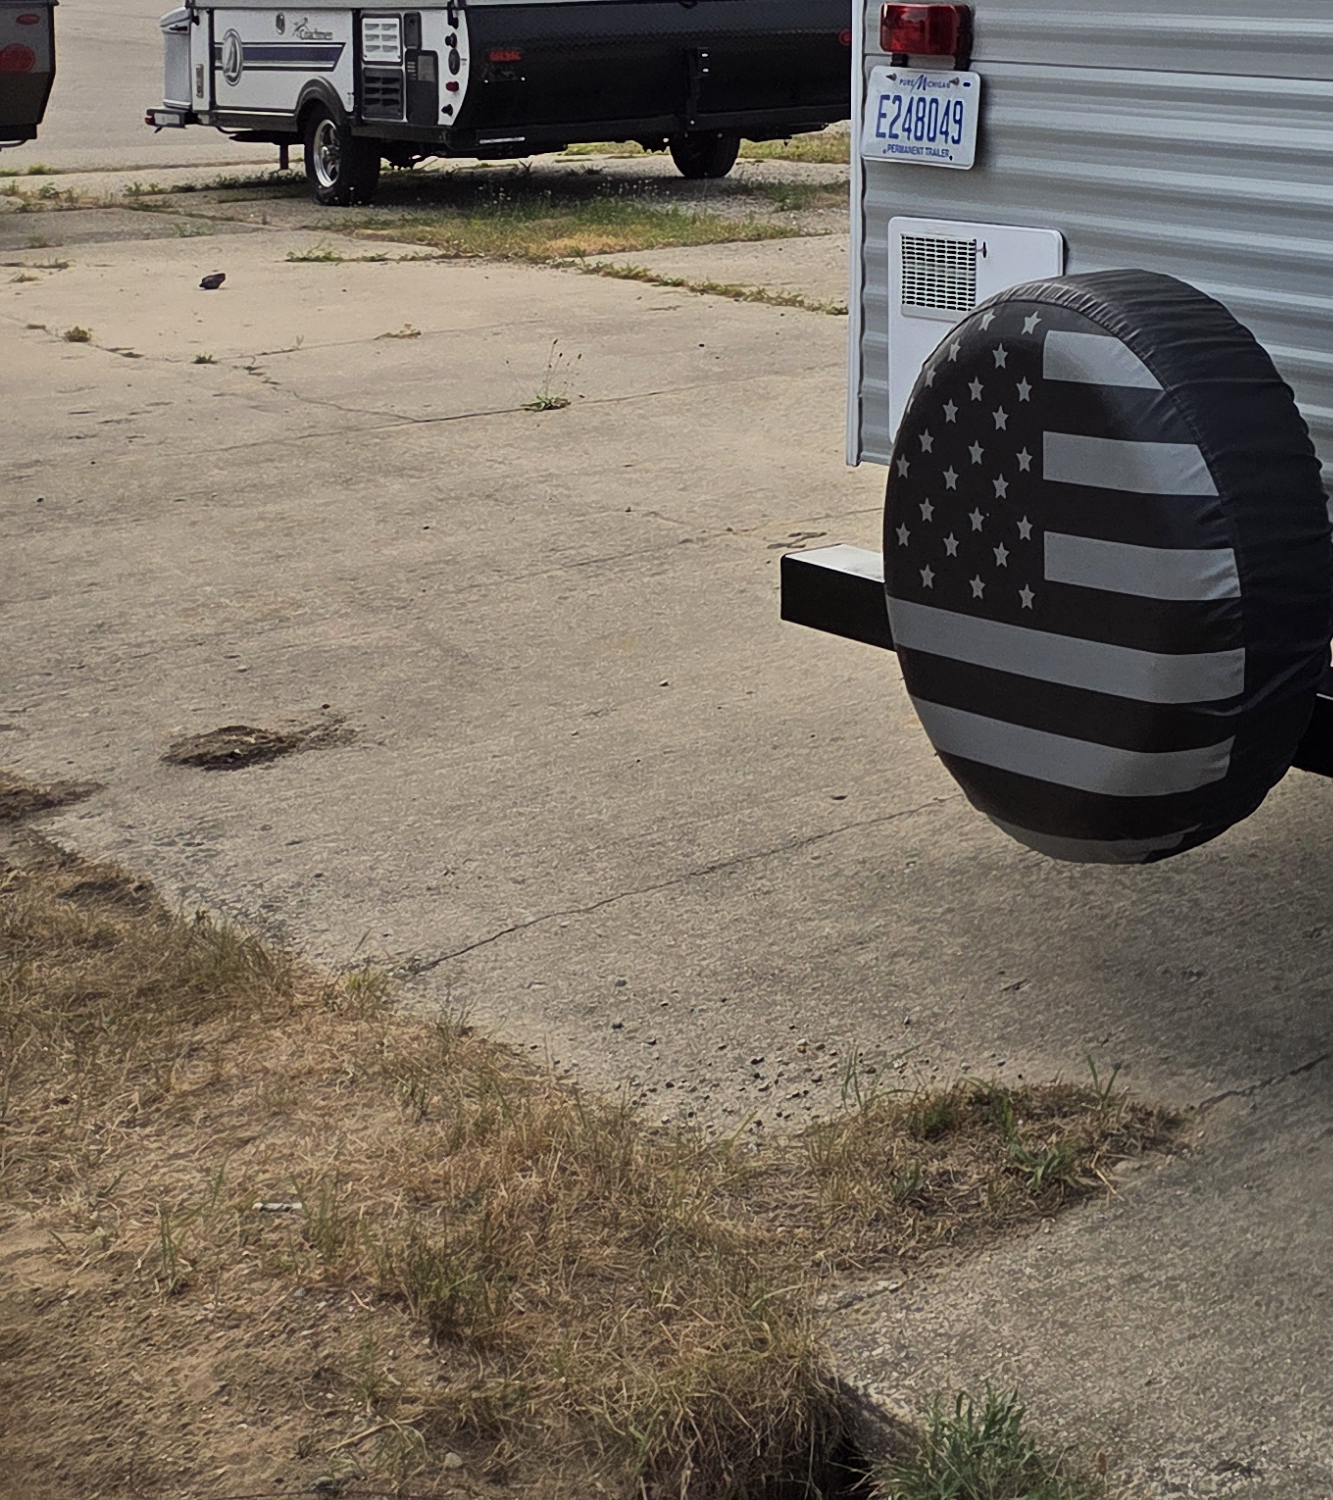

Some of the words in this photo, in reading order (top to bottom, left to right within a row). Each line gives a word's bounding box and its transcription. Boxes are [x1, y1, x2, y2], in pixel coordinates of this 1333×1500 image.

[876, 94, 963, 145] E248049
[887, 143, 924, 156] PERMANENT
[925, 146, 949, 158] TRAILER
